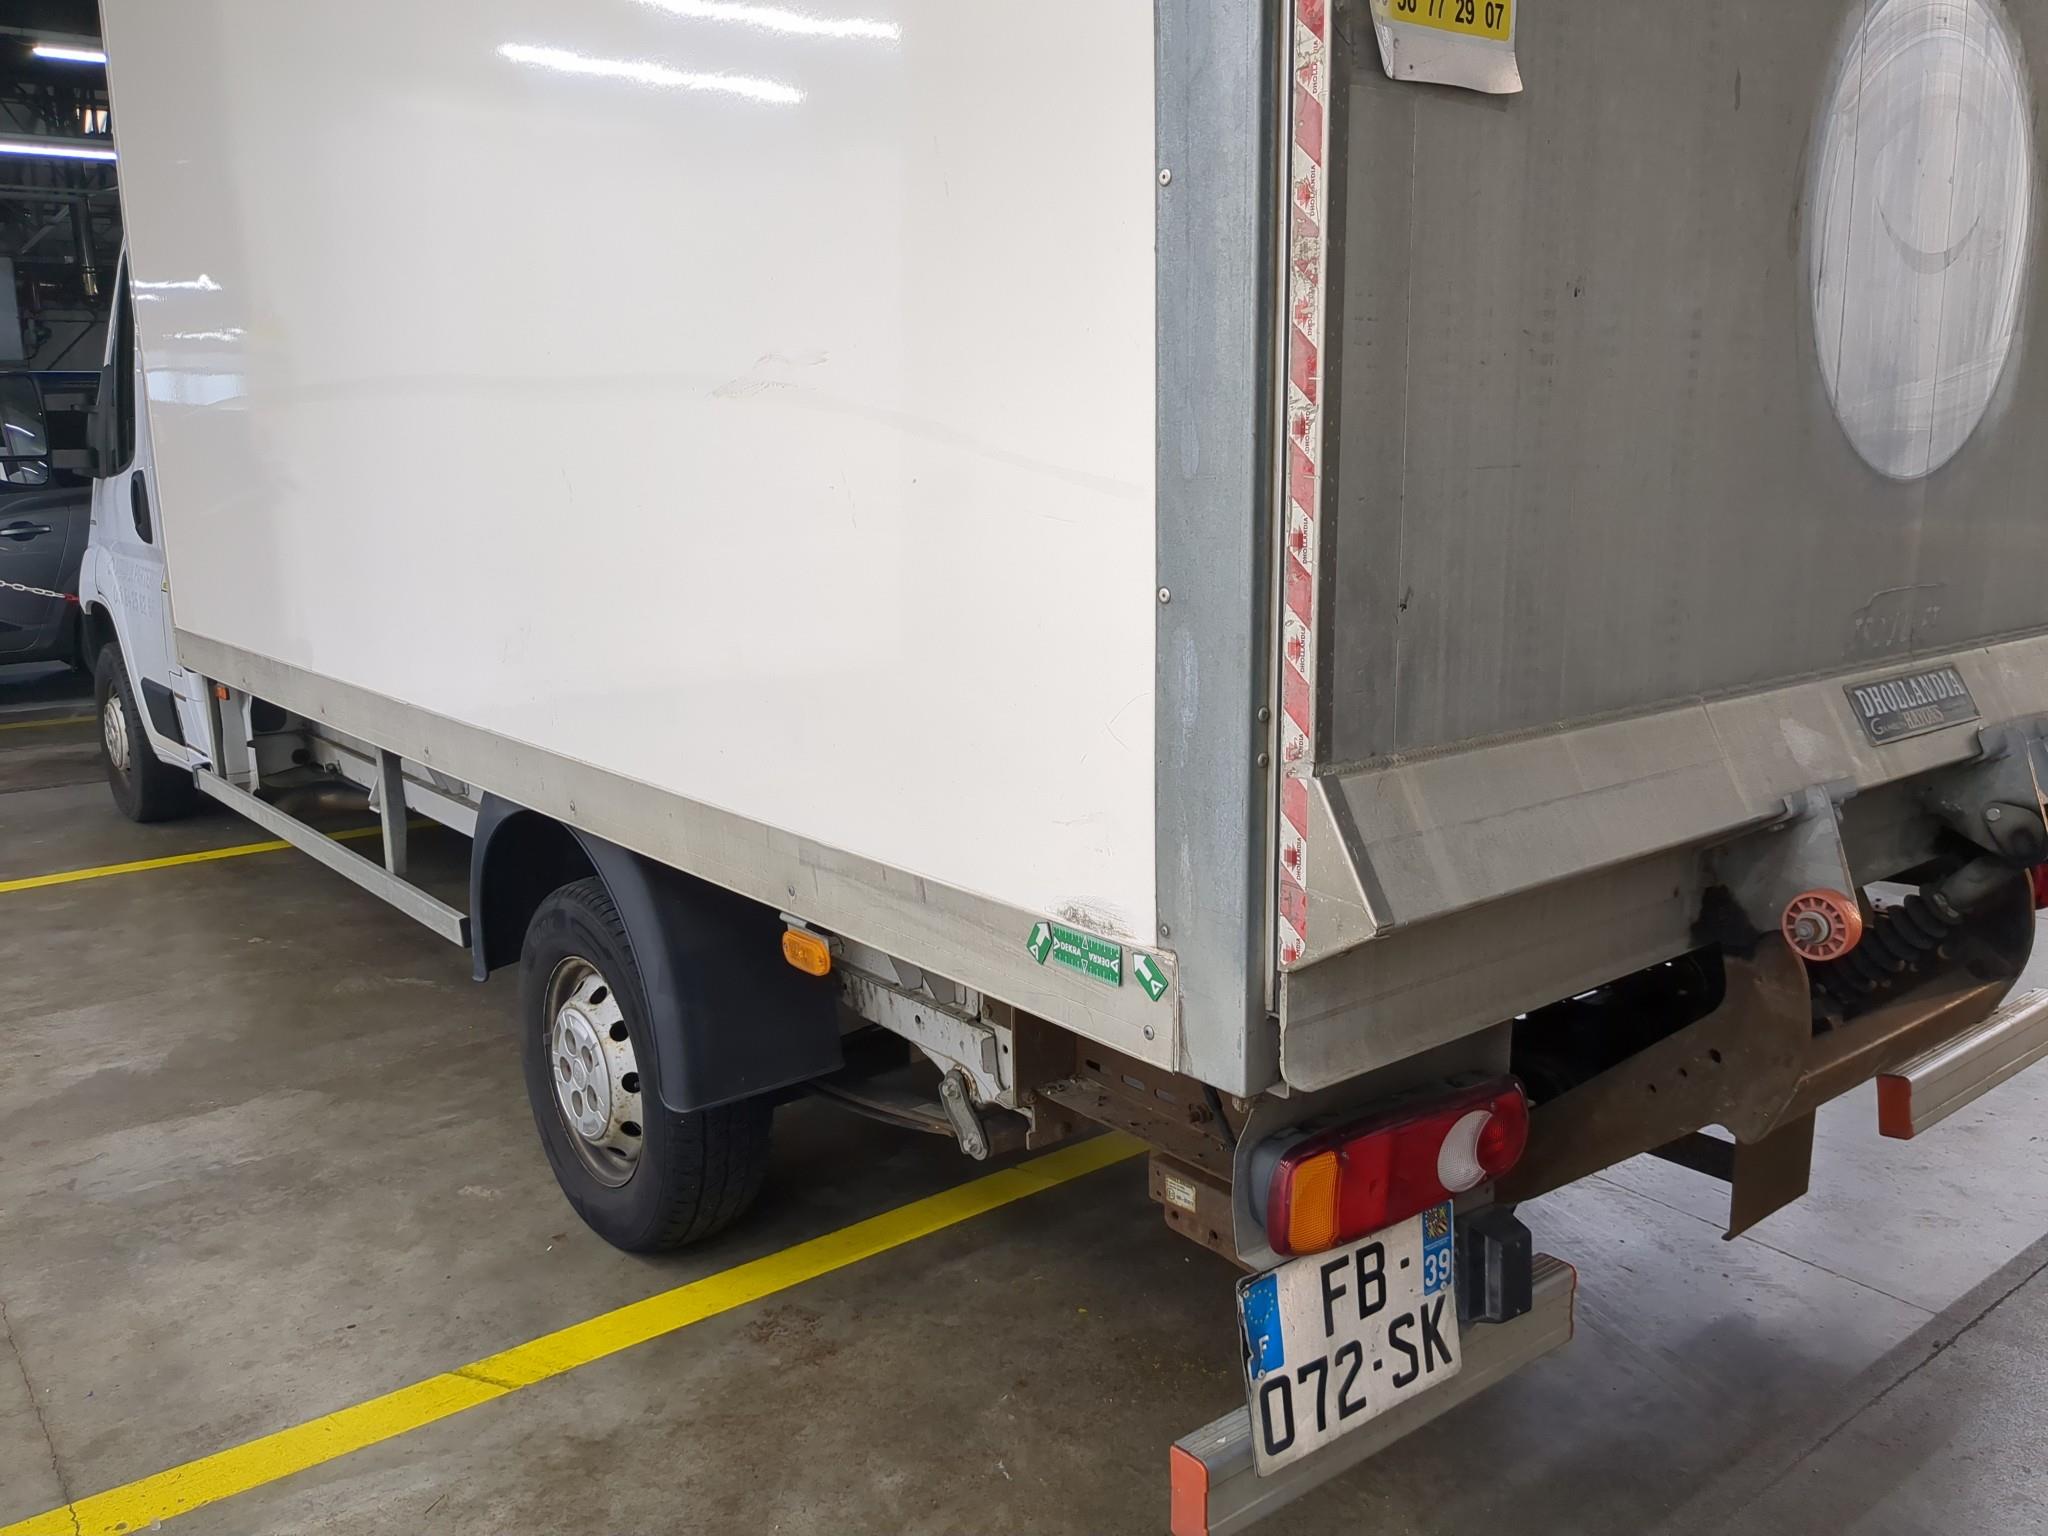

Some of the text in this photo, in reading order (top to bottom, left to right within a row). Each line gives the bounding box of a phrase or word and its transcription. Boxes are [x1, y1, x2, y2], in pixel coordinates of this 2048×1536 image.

[1454, 0, 1476, 24] 29
[1485, 1, 1505, 30] 07
[1854, 669, 1966, 717] DHOLLANDIA
[1060, 942, 1082, 957] DEKRA
[1088, 952, 1110, 968] DEKRA
[1424, 1247, 1452, 1288] 39
